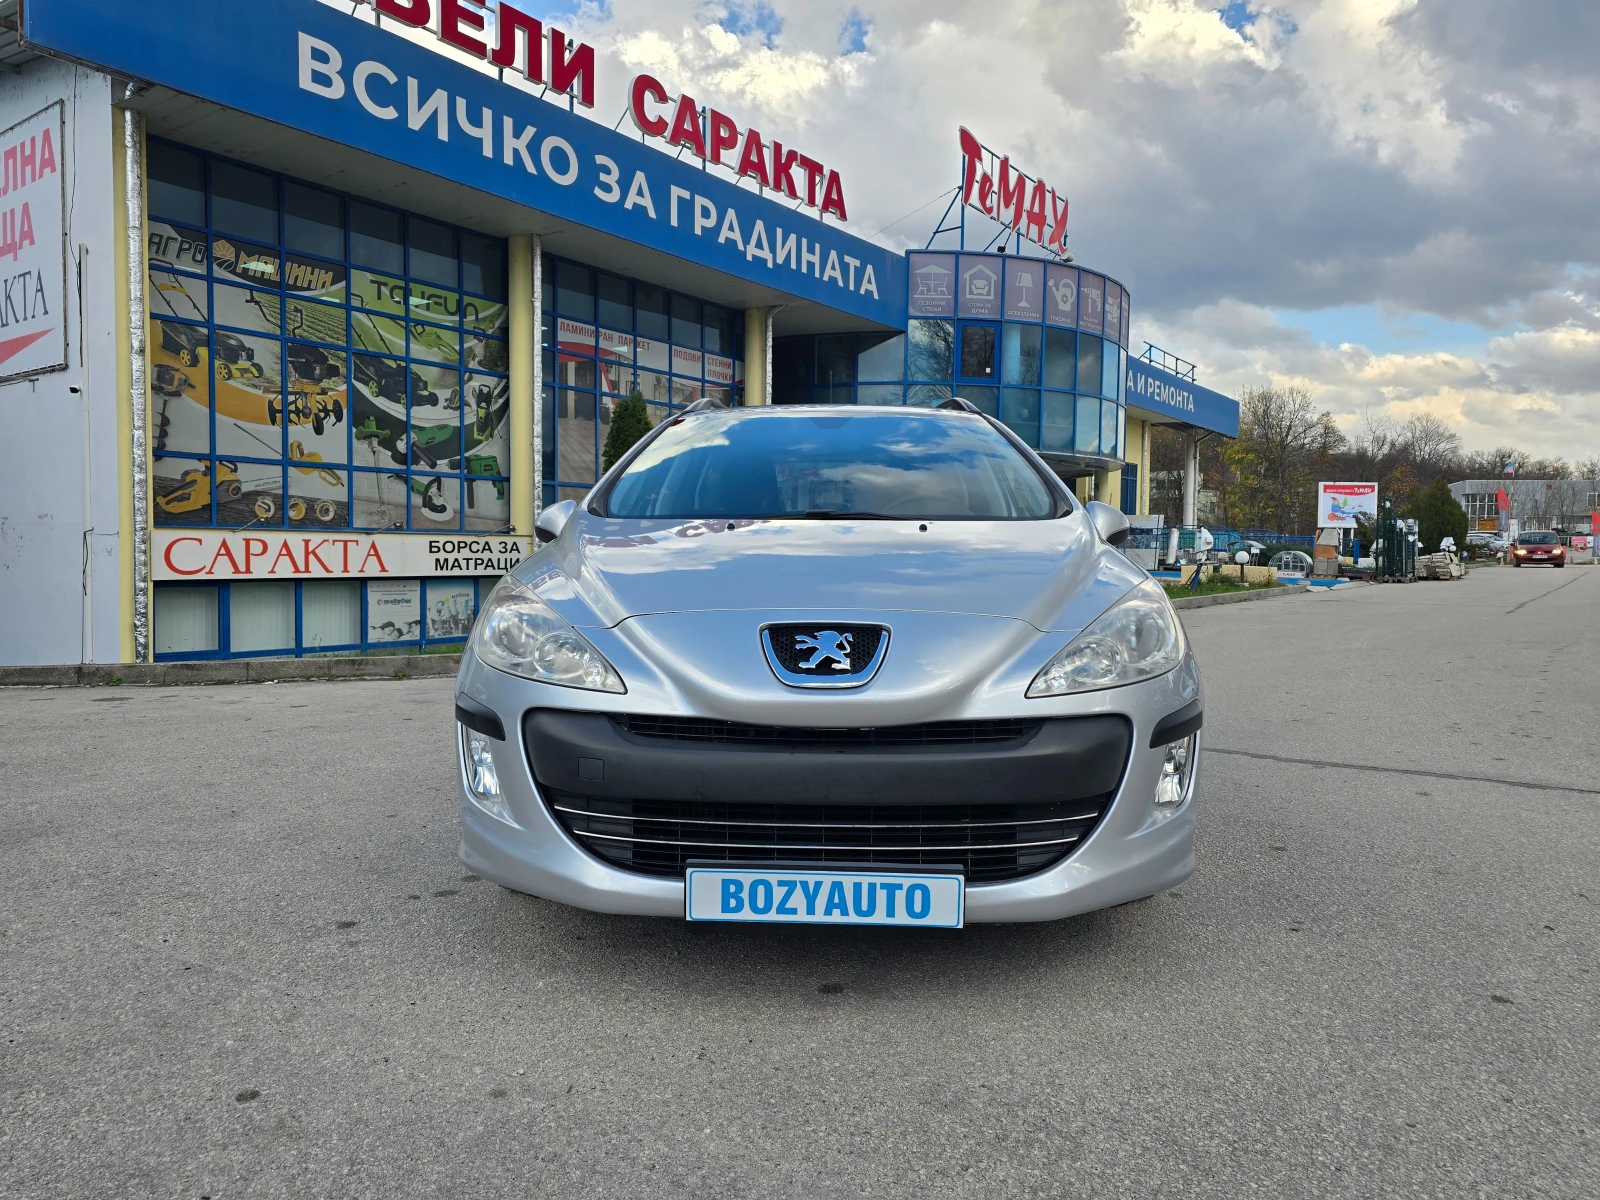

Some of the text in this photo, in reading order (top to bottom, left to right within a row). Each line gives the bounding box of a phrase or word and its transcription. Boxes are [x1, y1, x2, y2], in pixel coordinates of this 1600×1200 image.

[348, 0, 847, 221] ЕЛИ САРАКТА
[0, 127, 57, 198] ЛНА
[299, 31, 879, 299] ВСИЧКО ЗА ГРАДИНАТА
[149, 232, 207, 264] АГРО
[673, 348, 732, 370] ПОДОВИ СТЕННИ
[707, 369, 734, 383] ПЛОЧКИ
[1137, 372, 1145, 395] И
[1147, 377, 1195, 413] РЕМОНТА
[163, 536, 390, 576] САРАКТА
[428, 540, 521, 555] БОРСА ЗА
[434, 557, 521, 574] МАТРАЦИ
[720, 878, 931, 919] BOZYAUTO
